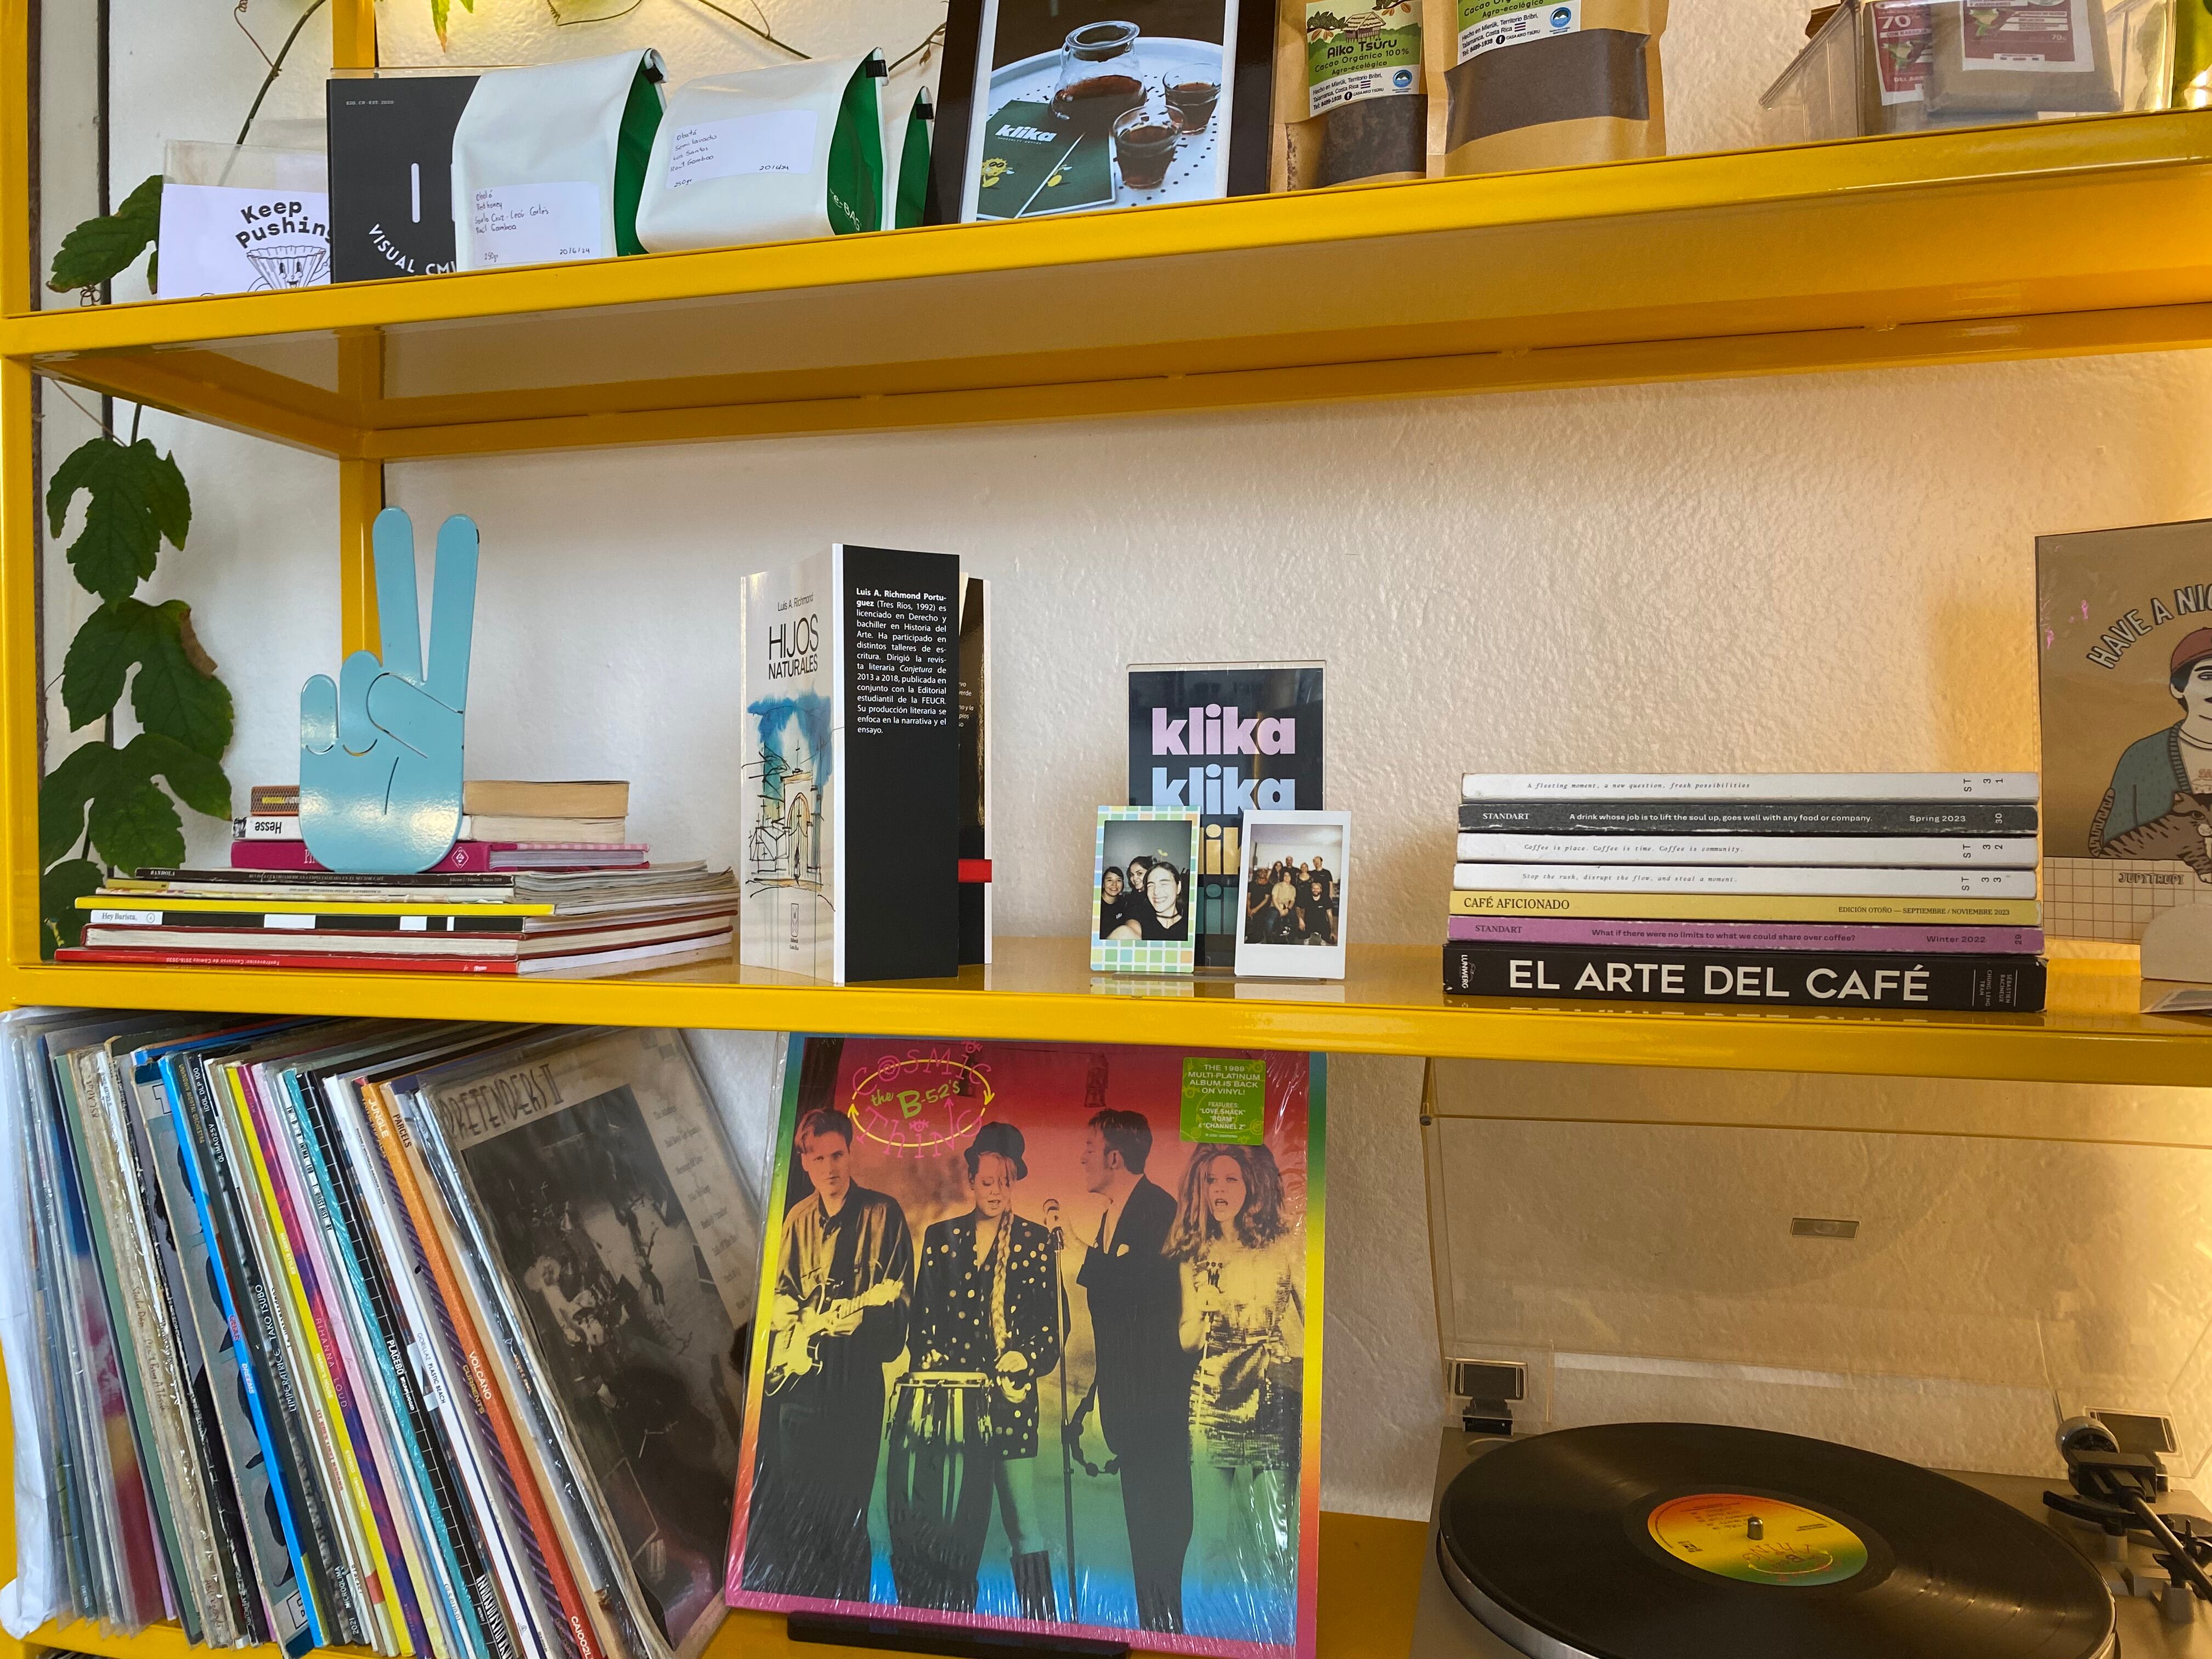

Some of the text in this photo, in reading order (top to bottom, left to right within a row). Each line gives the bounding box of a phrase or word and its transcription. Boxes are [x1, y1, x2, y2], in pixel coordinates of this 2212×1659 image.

[1464, 2, 1491, 16] Cacao
[1482, 0, 1544, 18] Agro-ecológico
[1358, 38, 1397, 52] Tsüru
[1485, 30, 1500, 38] Costa
[1315, 48, 1409, 73] Cacao Orgánico 100%
[1332, 60, 1387, 76] Agro-ecológico
[1335, 86, 1348, 94] Costa
[1348, 83, 1359, 92] Rica
[995, 124, 1058, 143] klika
[240, 201, 303, 225] Keep
[368, 223, 415, 273] VISUAL
[777, 592, 814, 612] Luis Richmond
[856, 588, 871, 596] Luis
[884, 590, 921, 600] Richmond
[923, 592, 947, 601] Portu-
[856, 609, 892, 619] licenciado
[909, 613, 938, 622] Derecho
[877, 600, 894, 608] (Tres
[917, 603, 935, 612] 1992)
[856, 620, 887, 629] bachiller
[904, 623, 931, 631] Historia
[2086, 608, 2154, 670] HAVE
[2150, 597, 2175, 626] A
[769, 613, 819, 661] HIJOS
[769, 653, 819, 680] NATURALES
[1152, 703, 1296, 755] klika
[1152, 763, 1296, 815] klika
[255, 821, 283, 834] Hesse
[1482, 812, 1530, 820] STANDART
[1627, 814, 1640, 822] job
[1909, 815, 1940, 823] Spring
[1995, 812, 2002, 825] 30
[2118, 872, 2185, 885] JUPITRUPI
[1463, 896, 1570, 910] CAFÉ AFICIONADO
[102, 912, 138, 921] Hey Barista,
[1475, 924, 1523, 934] STANDART
[2015, 934, 2022, 945] 29
[1509, 960, 1930, 1002] EL ARTE DEL CAFÉ
[852, 1047, 992, 1096] COSMIC
[1188, 1071, 1260, 1080] MULTI-PLATINUM
[193, 1067, 210, 1113] IDOL DLP 100
[871, 1080, 961, 1119] the B-52's
[178, 1064, 205, 1144] UNKNOWN MORTAL ORCHESTRA
[368, 1098, 390, 1139] JUNGLE
[392, 1113, 412, 1148] PARCELS
[255, 1284, 277, 1341] TAKO TSUBO
[315, 1317, 347, 1408] RIHANNA LOUD
[386, 1339, 405, 1376] PLACEBO
[417, 1332, 446, 1404] GORILLAZ PLASTIC BEACH
[469, 1350, 492, 1401] VOLCANO
[462, 1365, 486, 1415] CURRENTS
[334, 1566, 359, 1635] 2021 MICROQLIMA
